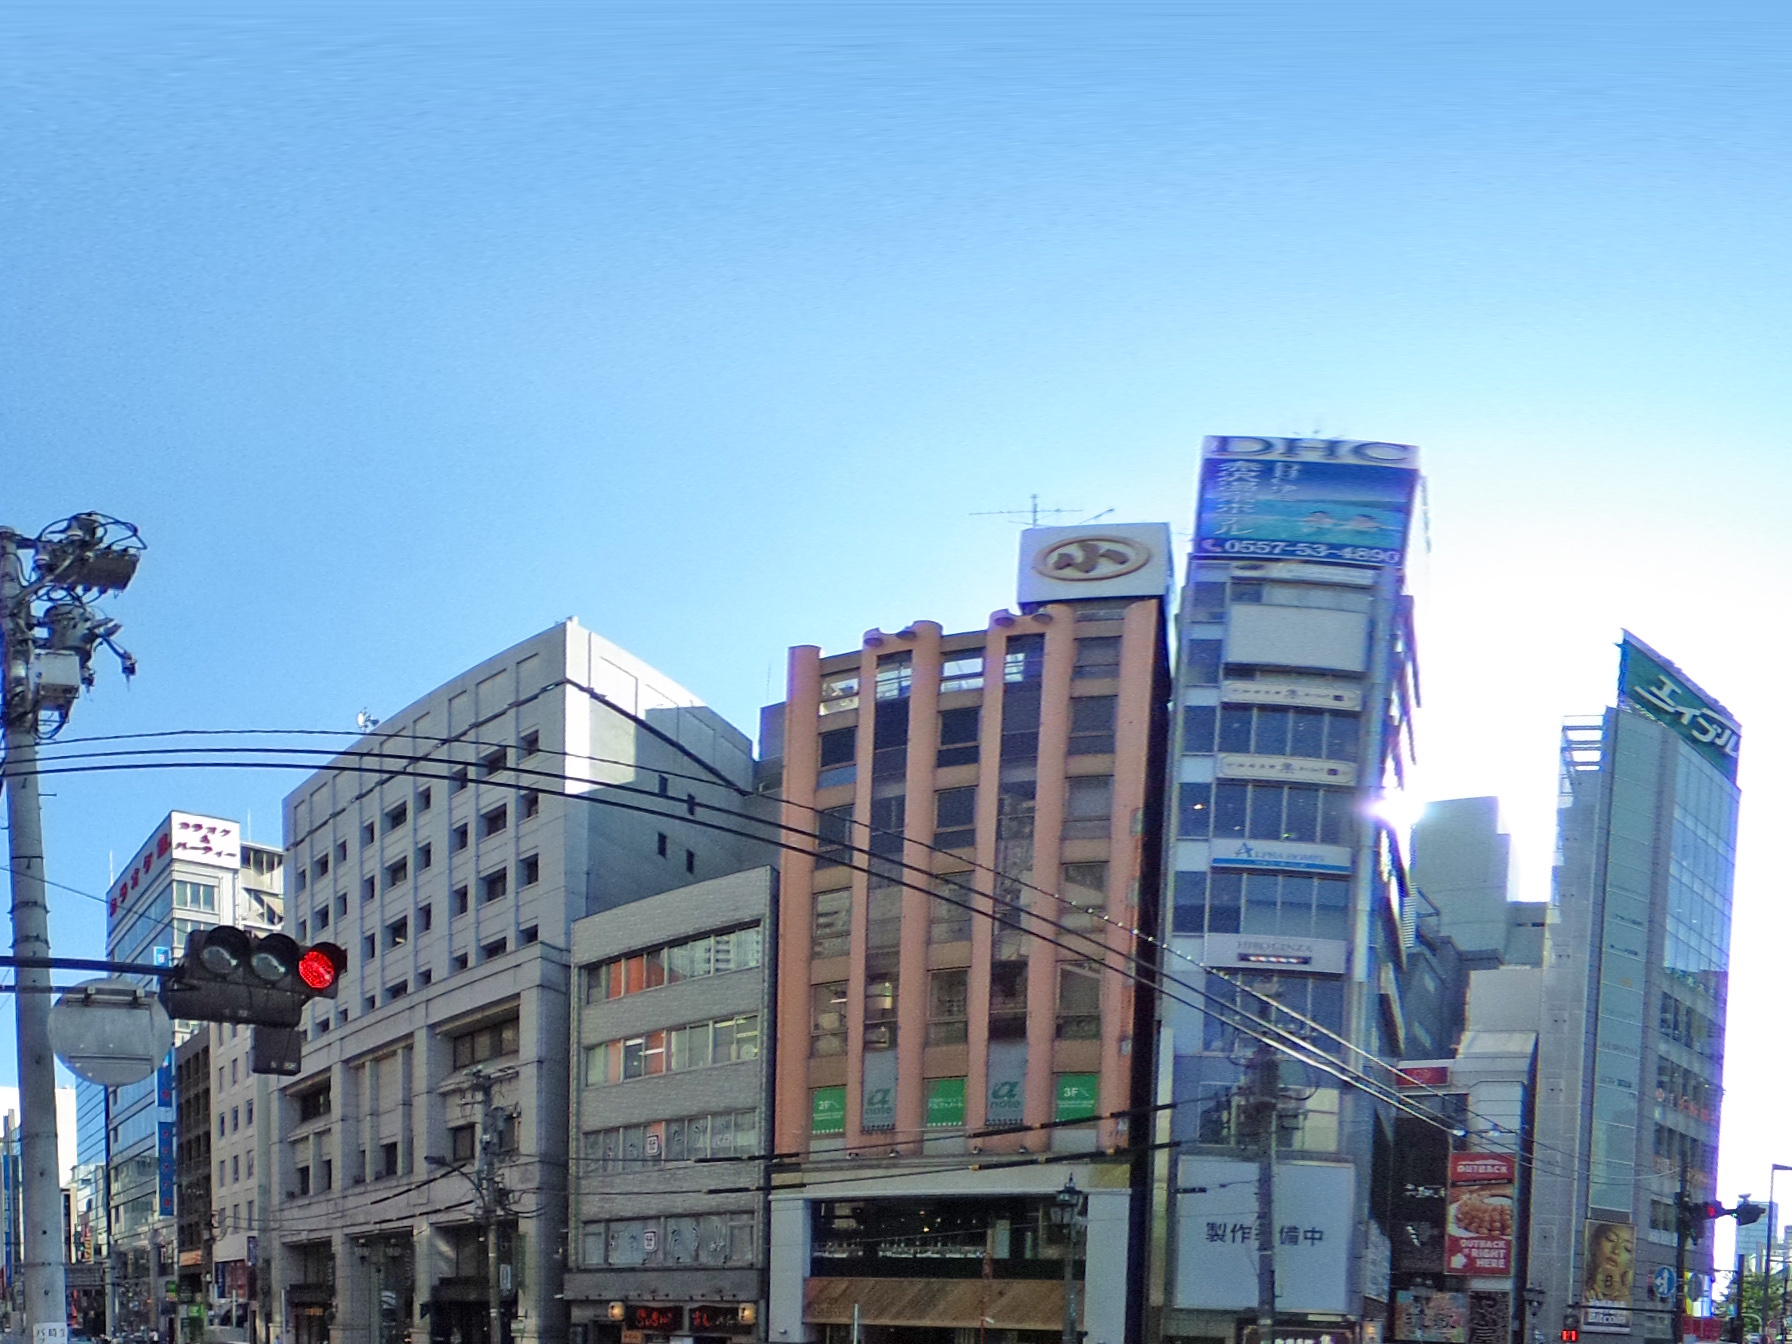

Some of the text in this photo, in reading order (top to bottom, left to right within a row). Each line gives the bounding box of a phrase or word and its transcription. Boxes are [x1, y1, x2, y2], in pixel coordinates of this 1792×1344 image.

[1214, 436, 1409, 464] DHC
[1634, 674, 1738, 759] エイブル
[1456, 1164, 1508, 1174] OUTBACK
[1460, 1239, 1506, 1249] OUTBACK
[1471, 1248, 1506, 1258] RIGHT
[1476, 1258, 1506, 1268] HERE
